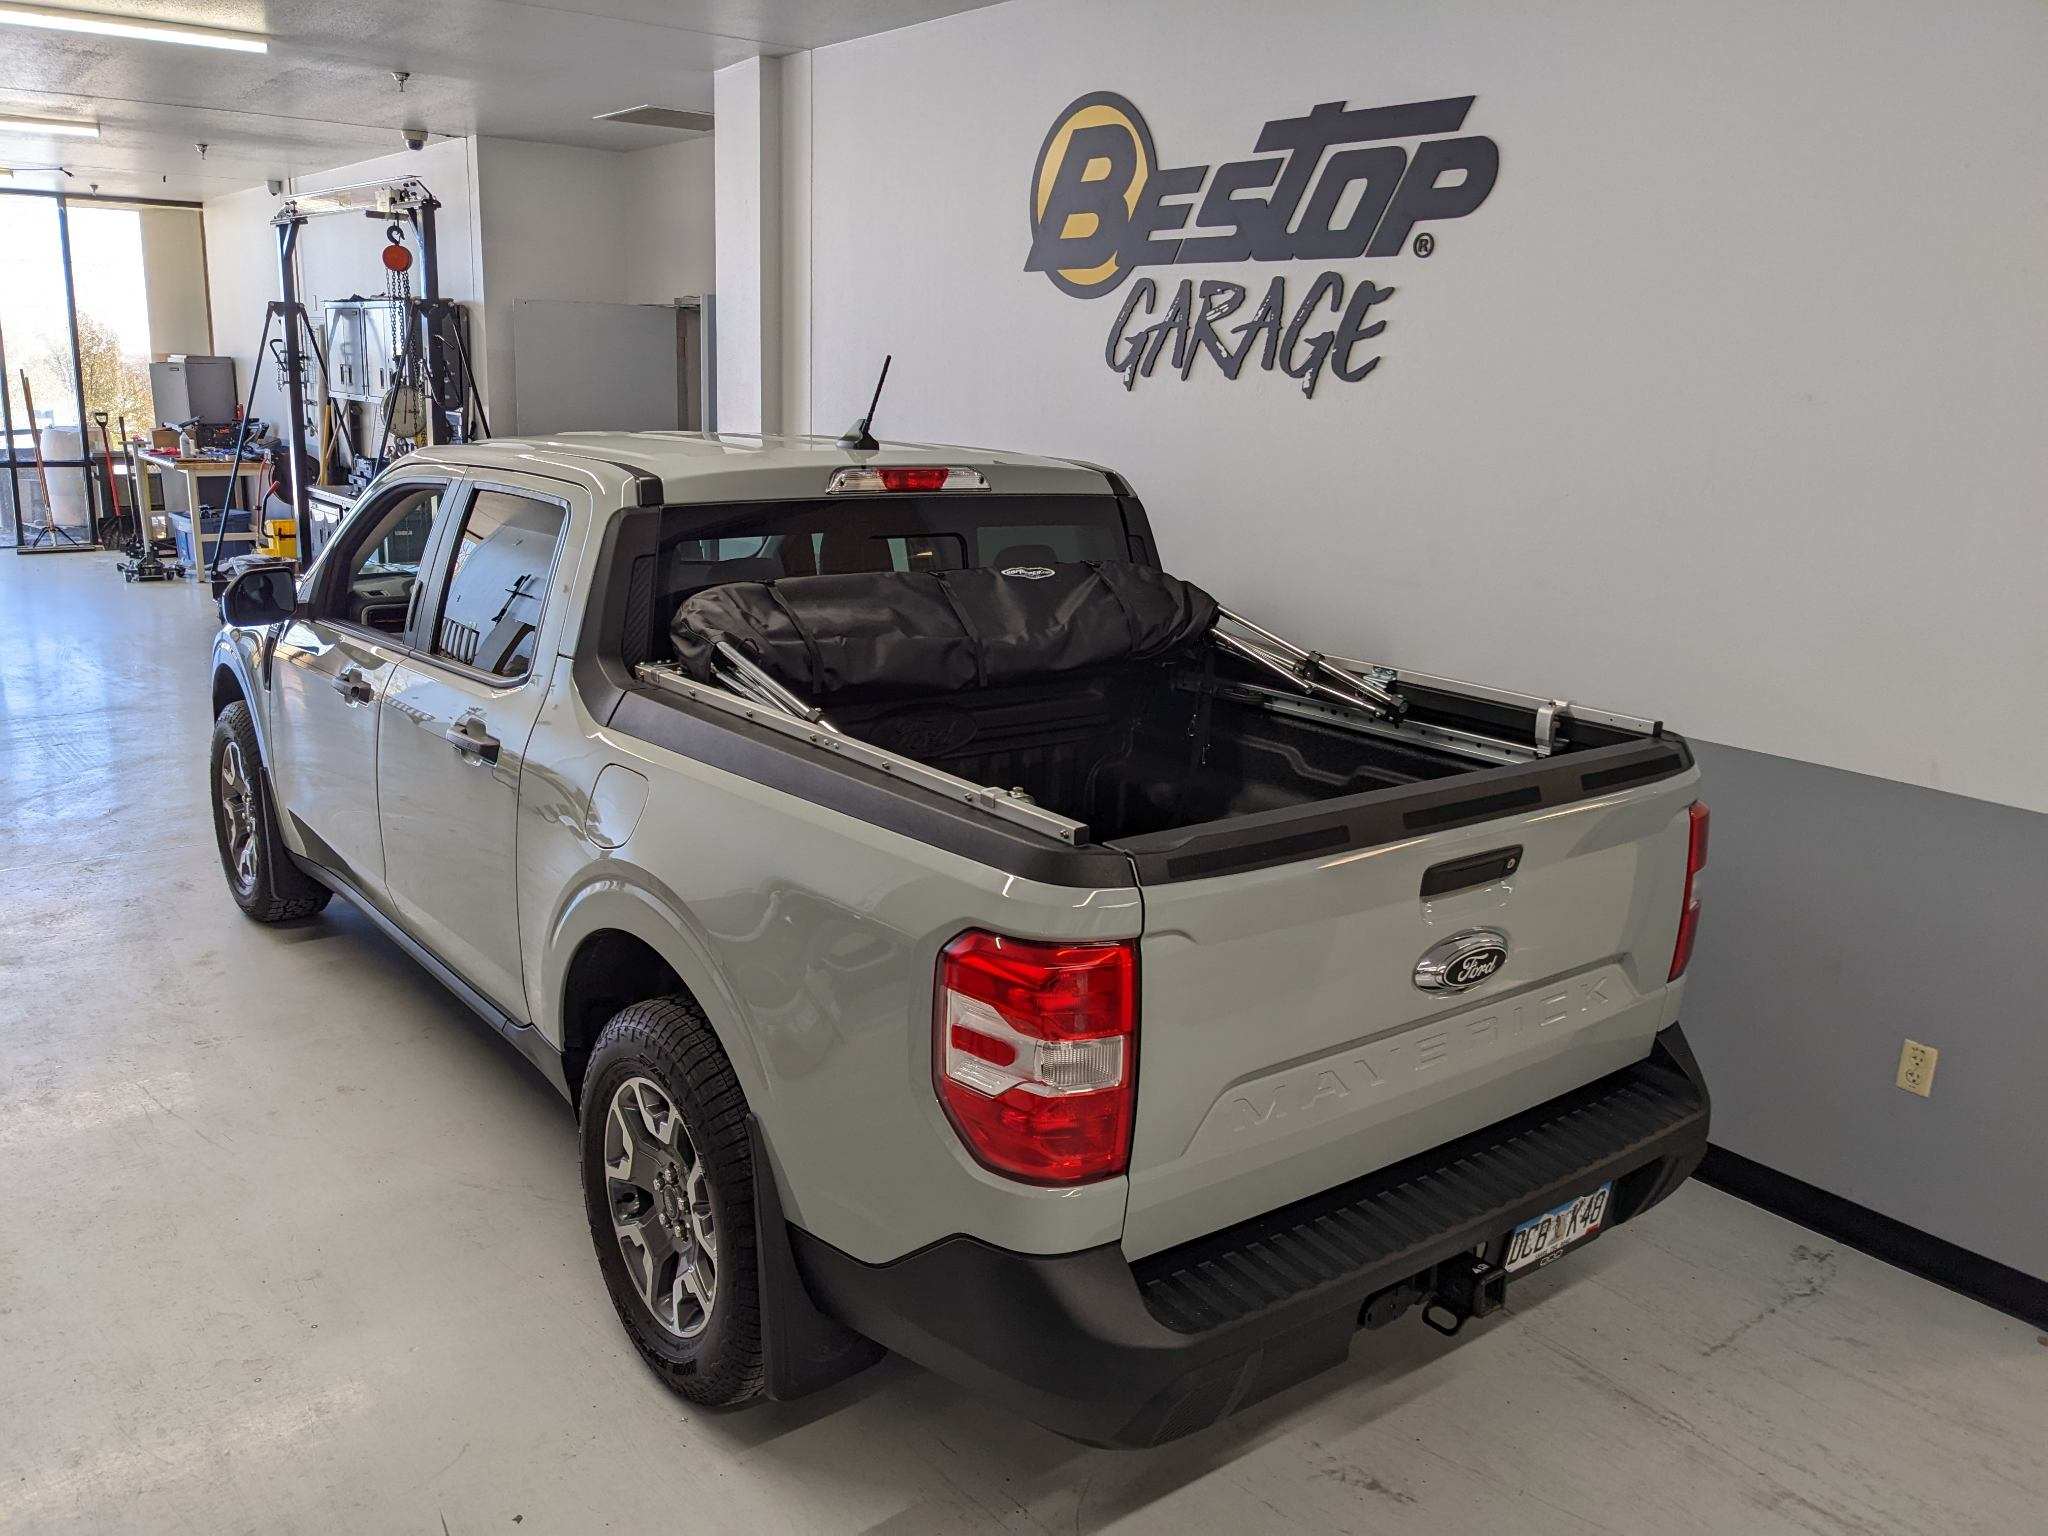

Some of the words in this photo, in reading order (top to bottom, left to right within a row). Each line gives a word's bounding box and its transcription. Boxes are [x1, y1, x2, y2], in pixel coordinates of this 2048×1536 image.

[1105, 271, 1395, 399] GARAGE
[1457, 952, 1498, 982] Ford
[1232, 976, 1610, 1133] MAVERICK
